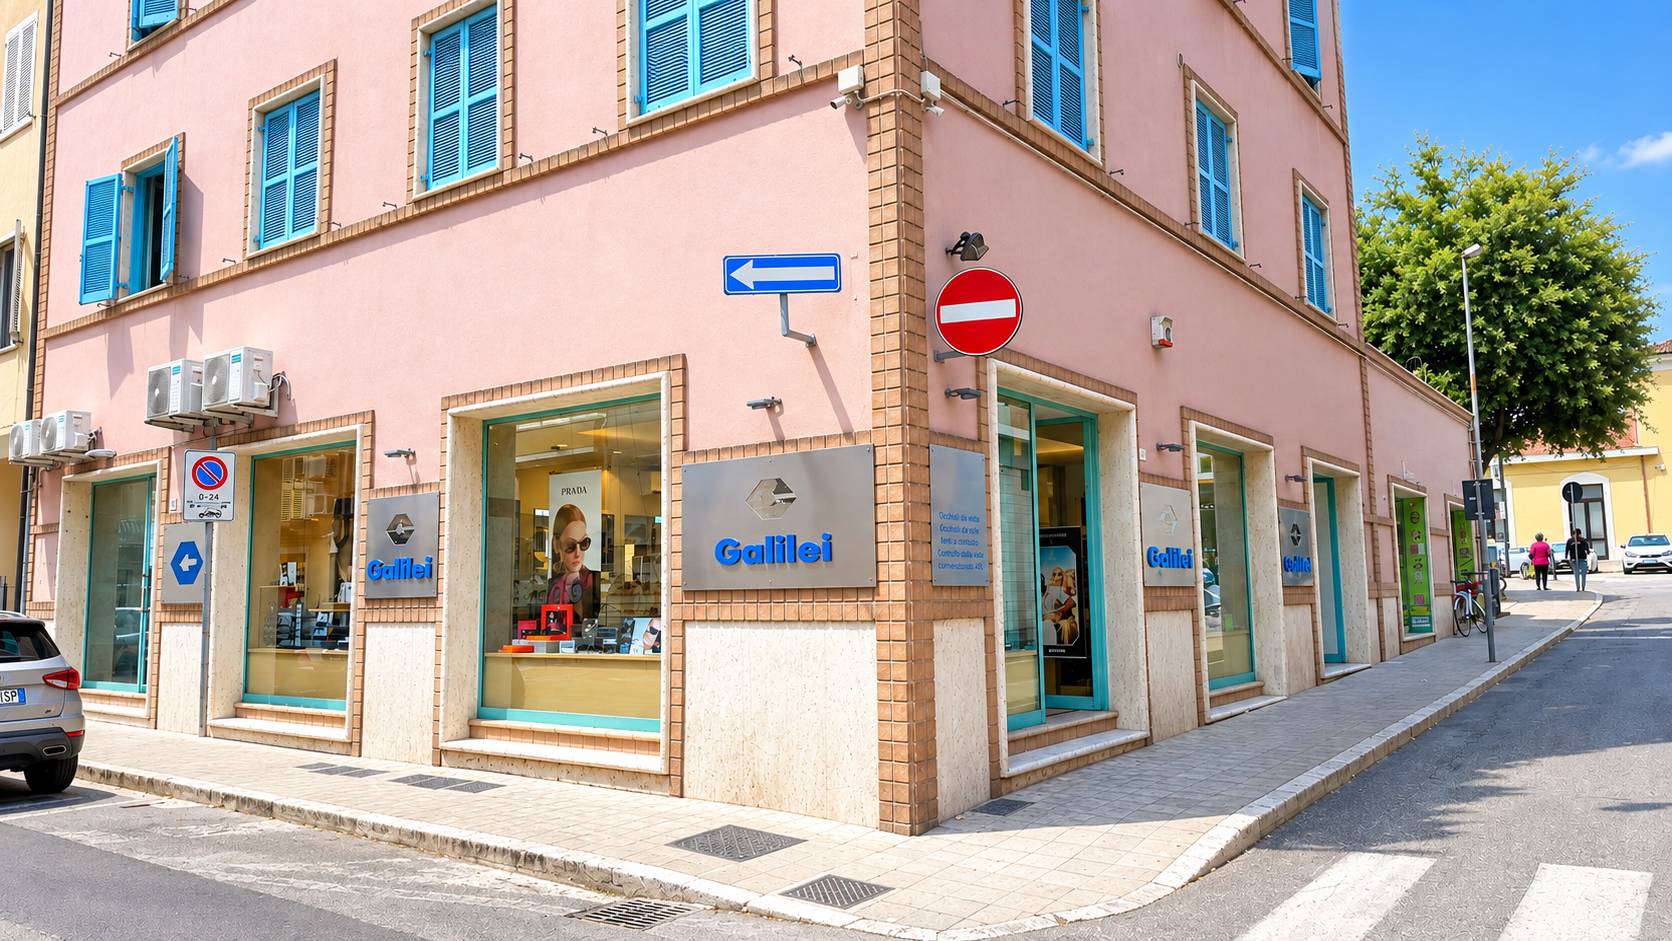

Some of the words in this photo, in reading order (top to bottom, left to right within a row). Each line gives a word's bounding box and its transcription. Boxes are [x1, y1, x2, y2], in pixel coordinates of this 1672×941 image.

[198, 493, 219, 501] 0-24
[561, 486, 588, 496] PRADA
[715, 532, 833, 566] Galilei
[1146, 546, 1193, 569] Galilei
[367, 556, 433, 581] Galilei
